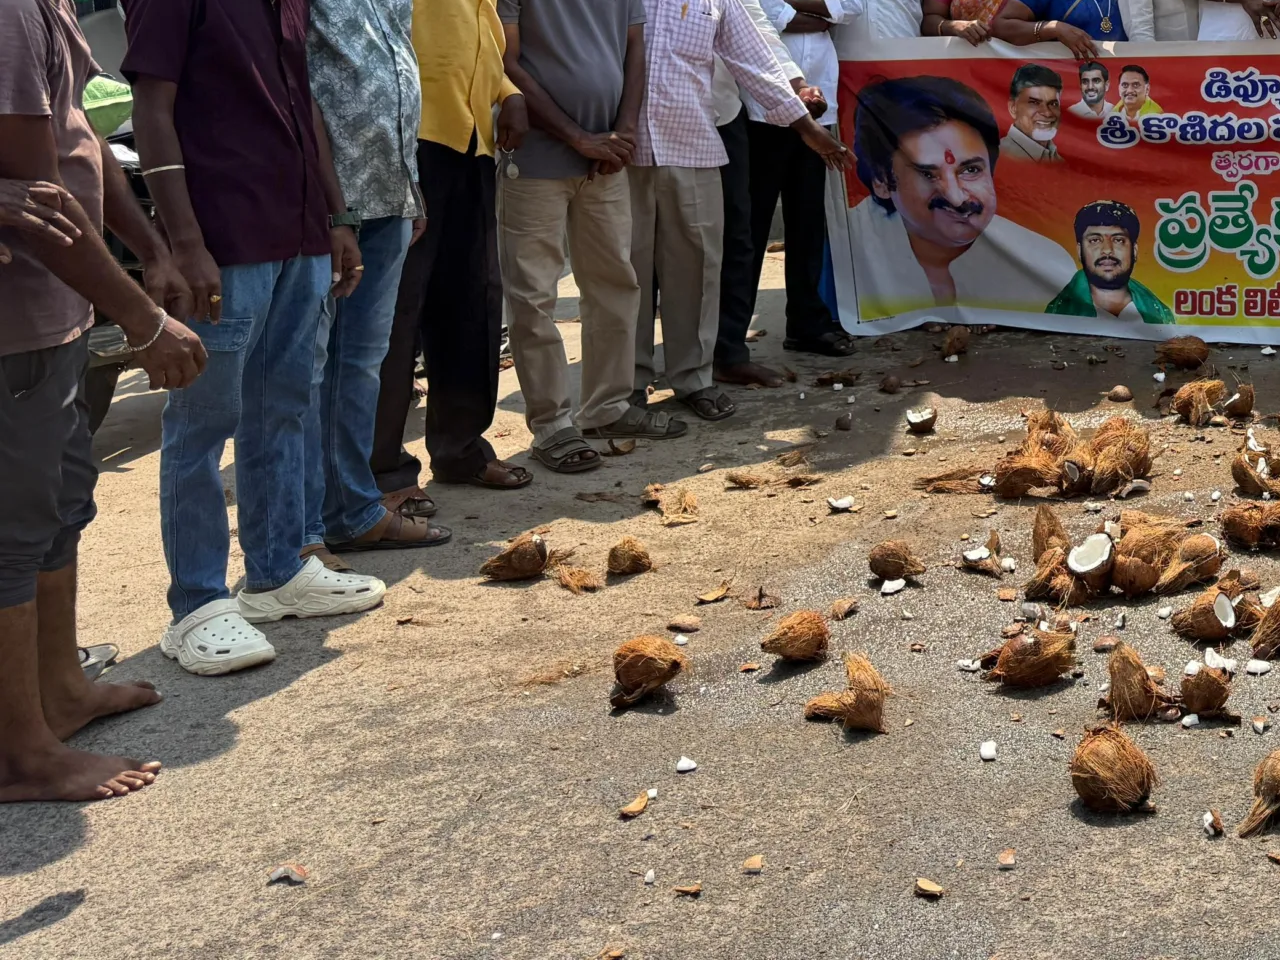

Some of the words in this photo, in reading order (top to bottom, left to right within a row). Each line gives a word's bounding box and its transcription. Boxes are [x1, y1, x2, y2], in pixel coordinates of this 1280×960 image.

[1100, 115, 1137, 144] శ్రీ
[1141, 115, 1264, 141] కొణిదల
[1214, 153, 1280, 178] త్వరగా
[1174, 285, 1238, 316] లంక
